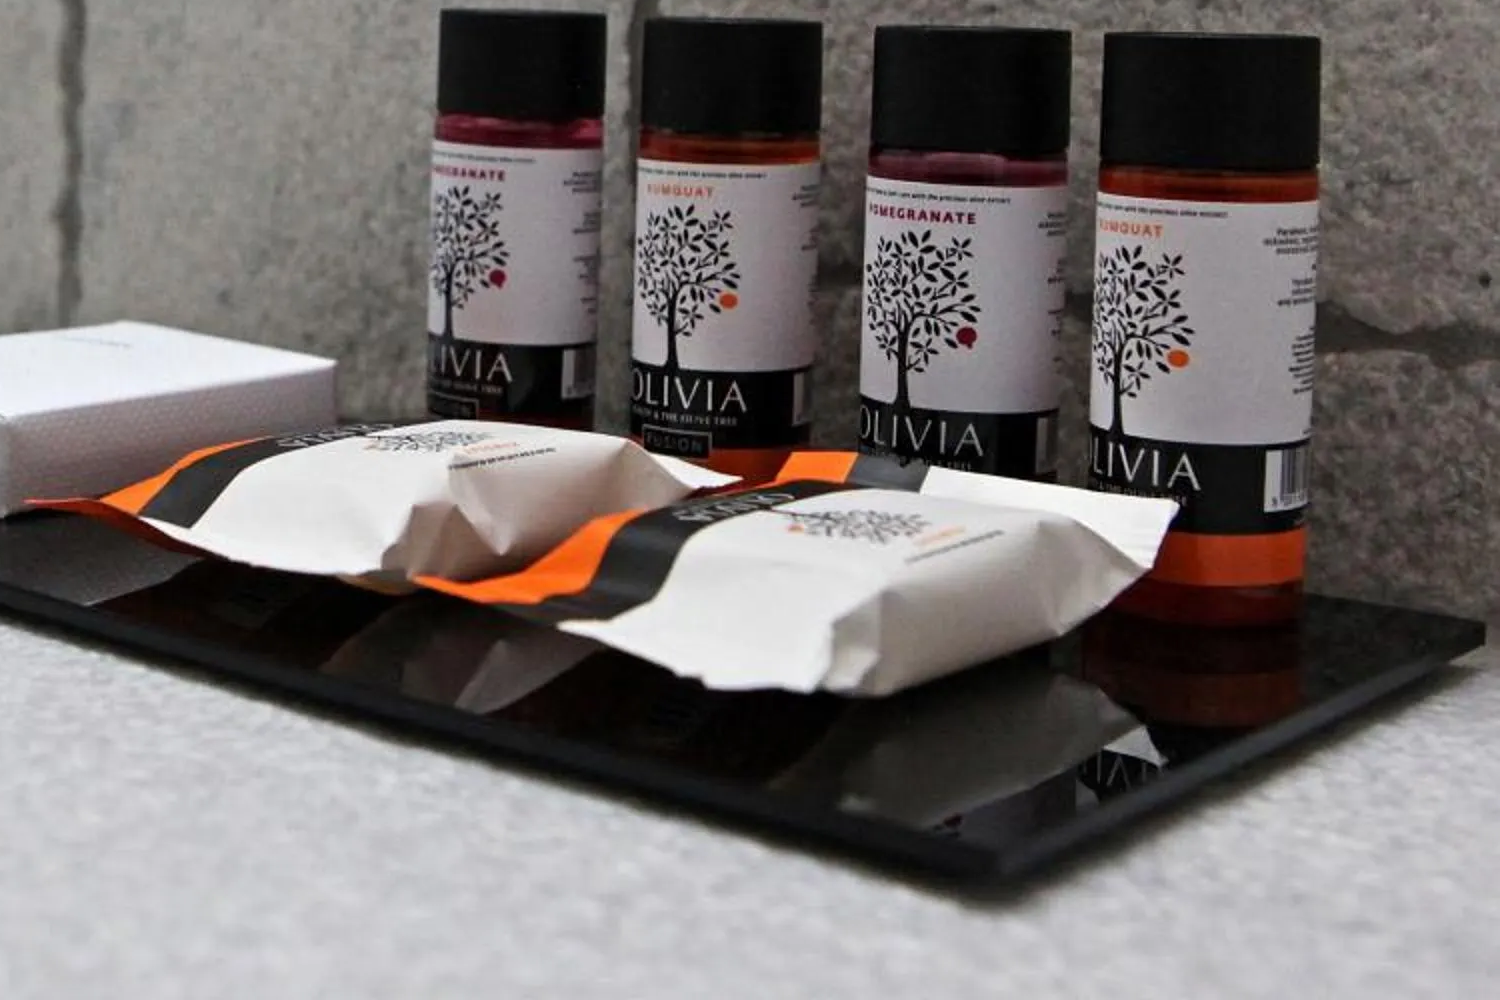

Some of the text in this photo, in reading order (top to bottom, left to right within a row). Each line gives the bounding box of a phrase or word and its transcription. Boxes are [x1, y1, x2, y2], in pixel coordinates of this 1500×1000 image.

[869, 201, 977, 225] POMEGRANATE
[1099, 219, 1163, 238] UMQUAT
[631, 367, 748, 414] OLIVIA
[860, 404, 984, 457] OLIVIA
[1089, 436, 1202, 492] LIVIA
